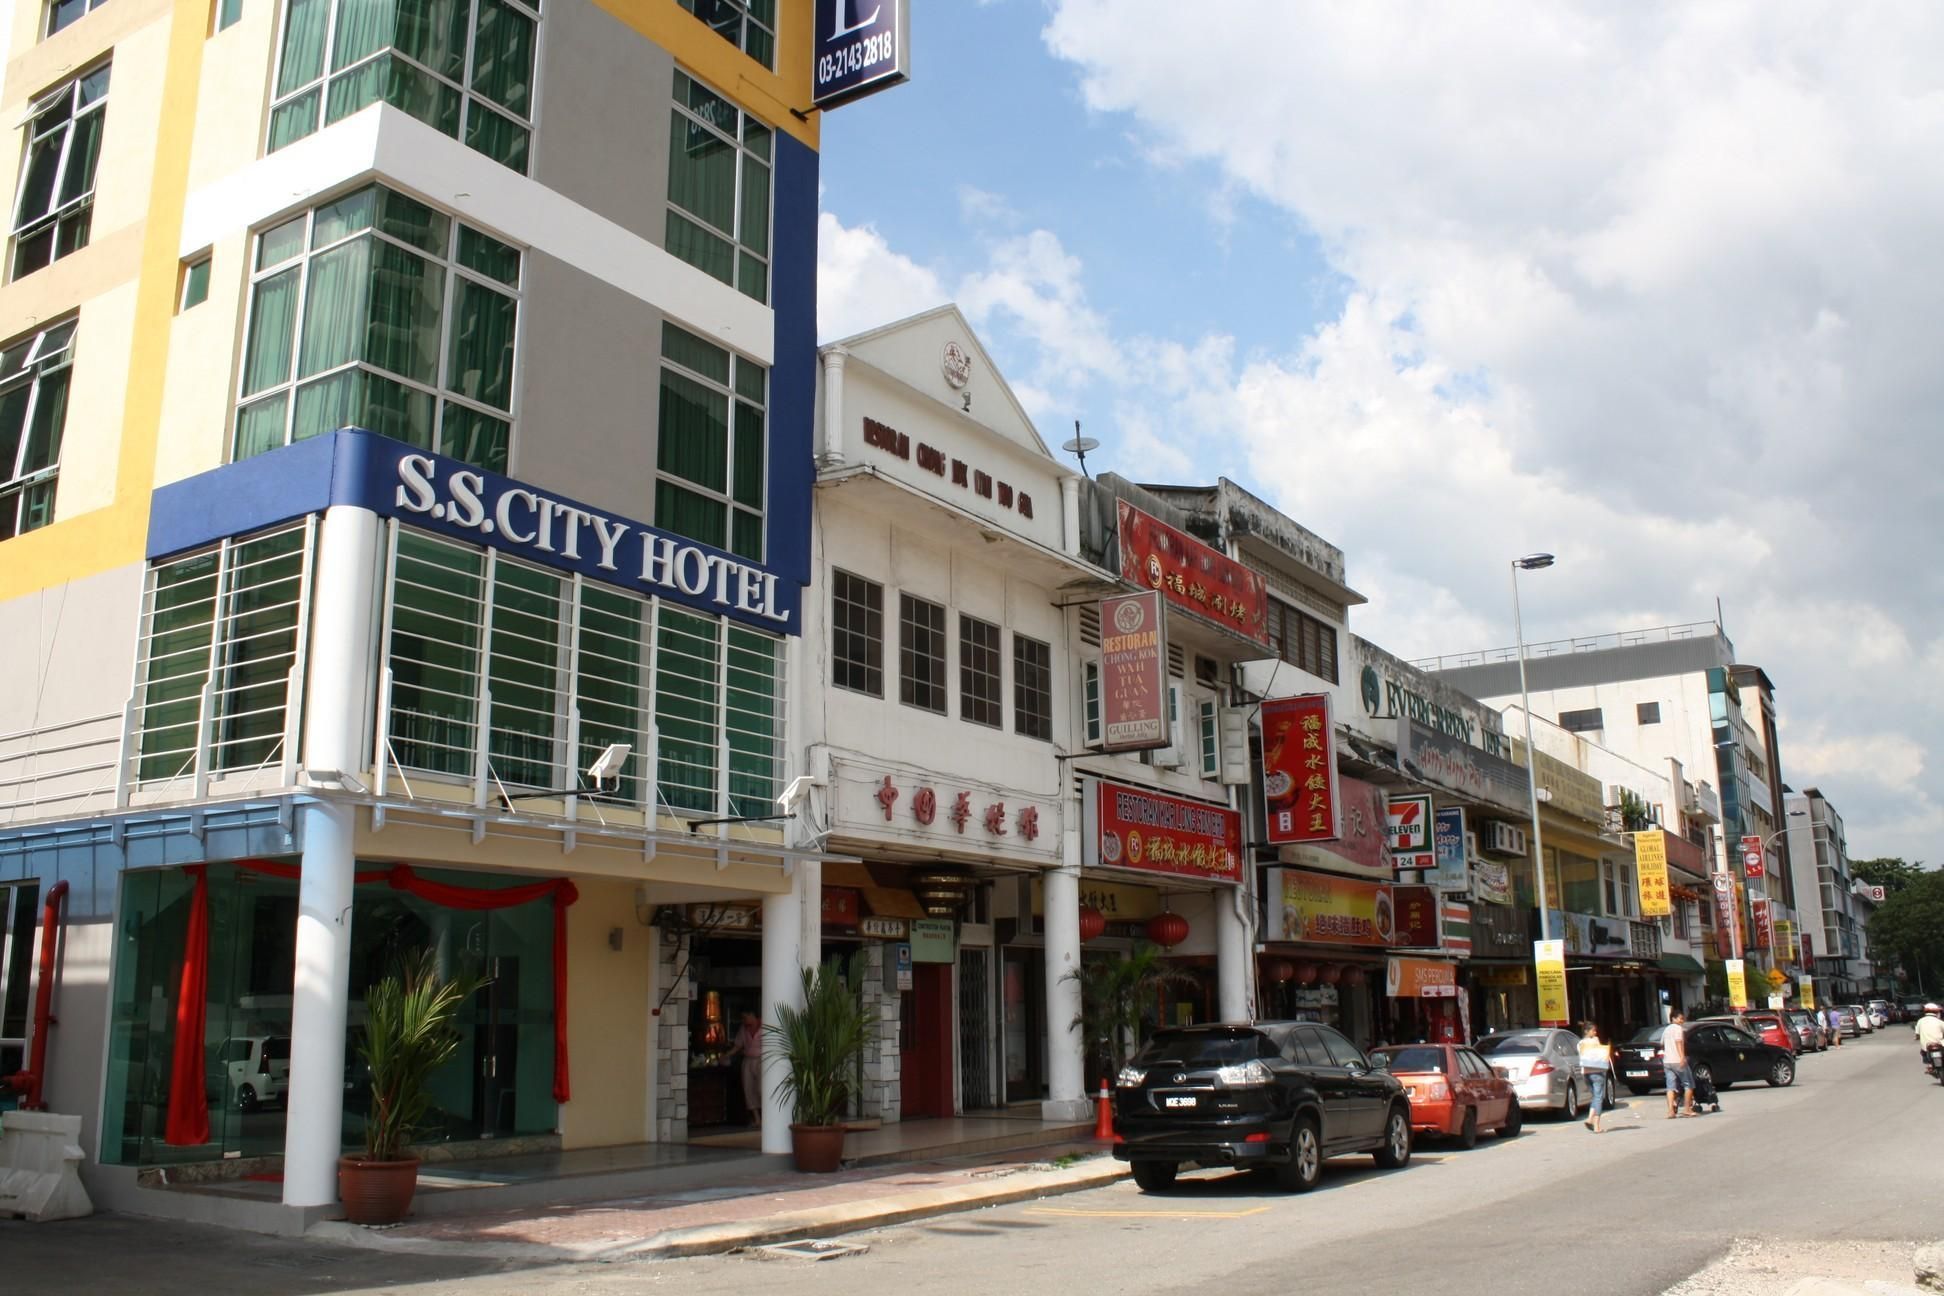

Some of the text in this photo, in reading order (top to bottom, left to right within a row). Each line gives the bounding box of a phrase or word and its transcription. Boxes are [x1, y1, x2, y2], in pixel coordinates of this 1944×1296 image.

[818, 30, 892, 85] 03-2143 2818
[637, 531, 790, 623] HOTEL
[1103, 630, 1158, 654] RESTORAN
[1103, 648, 1158, 665] CHONG KOK
[1117, 661, 1145, 674] WAH
[1117, 792, 1159, 827] RESTORAN
[1389, 802, 1420, 848] 7
[1400, 857, 1413, 866] 24
